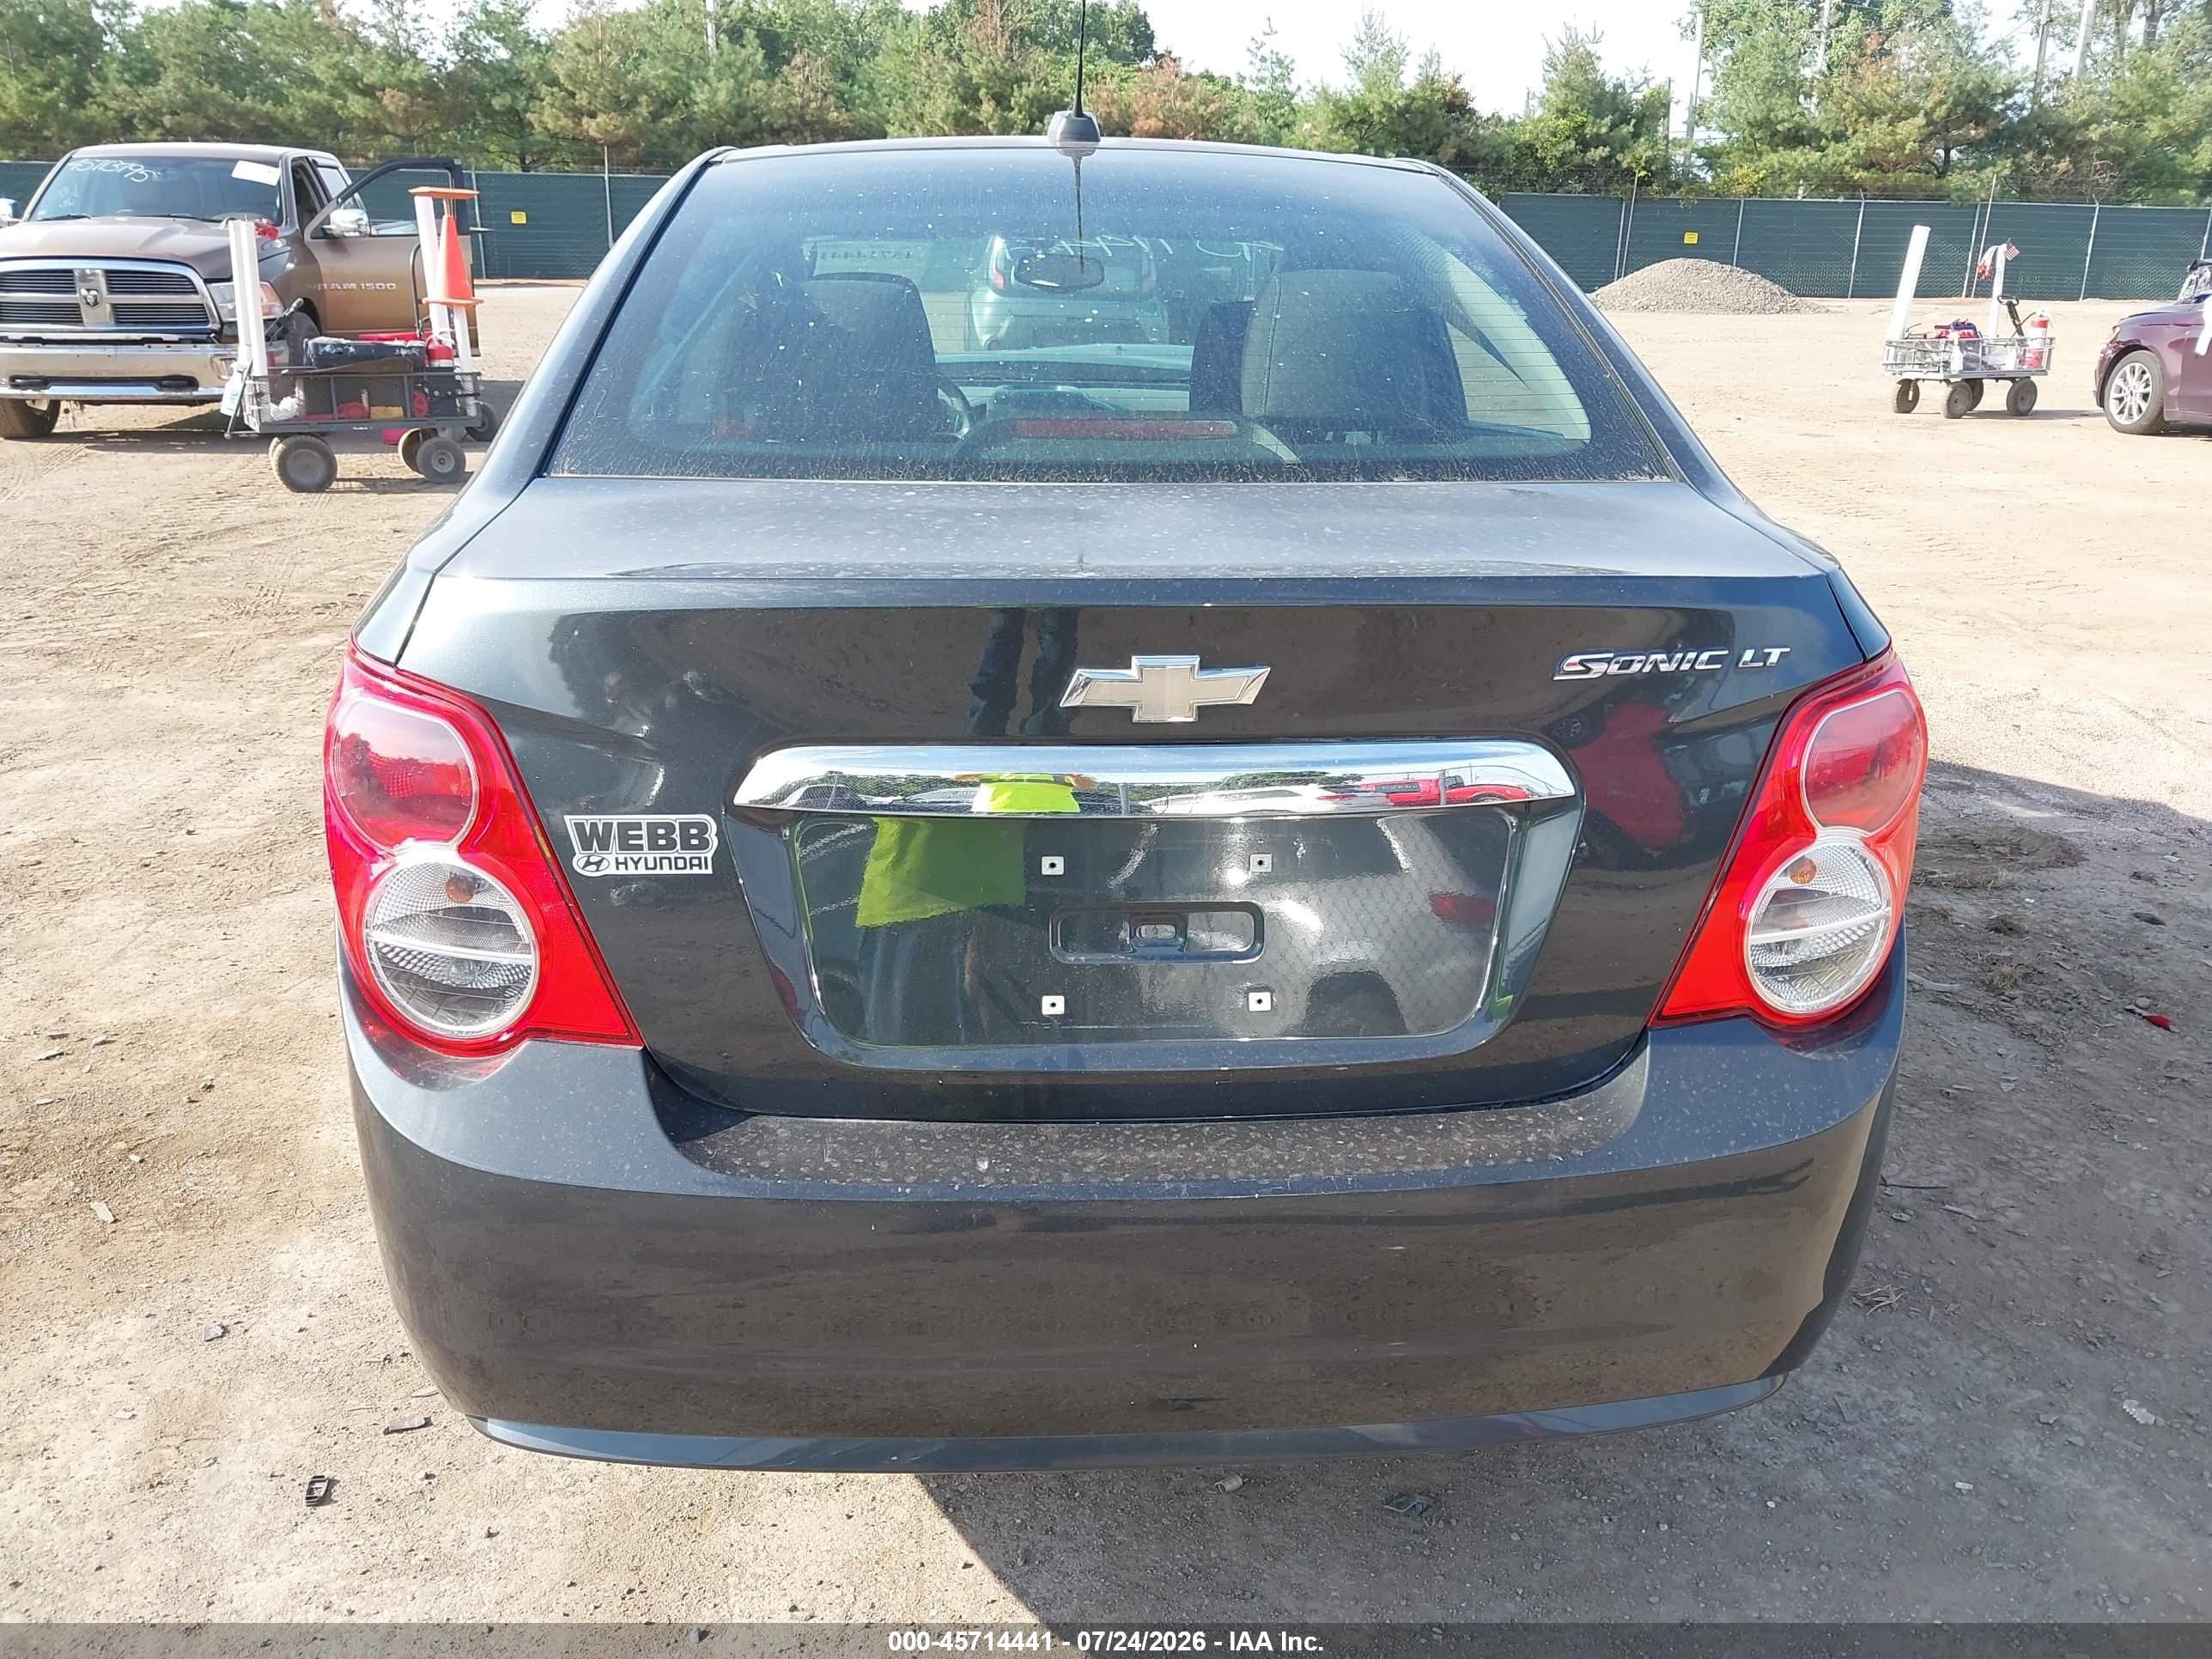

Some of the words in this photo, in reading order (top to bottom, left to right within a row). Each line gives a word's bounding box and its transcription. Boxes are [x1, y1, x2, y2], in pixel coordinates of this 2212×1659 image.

[1553, 650, 1729, 681] SONIC
[1738, 647, 1791, 668] LT
[570, 818, 714, 853] WEBB
[615, 856, 708, 871] HYUNDAI
